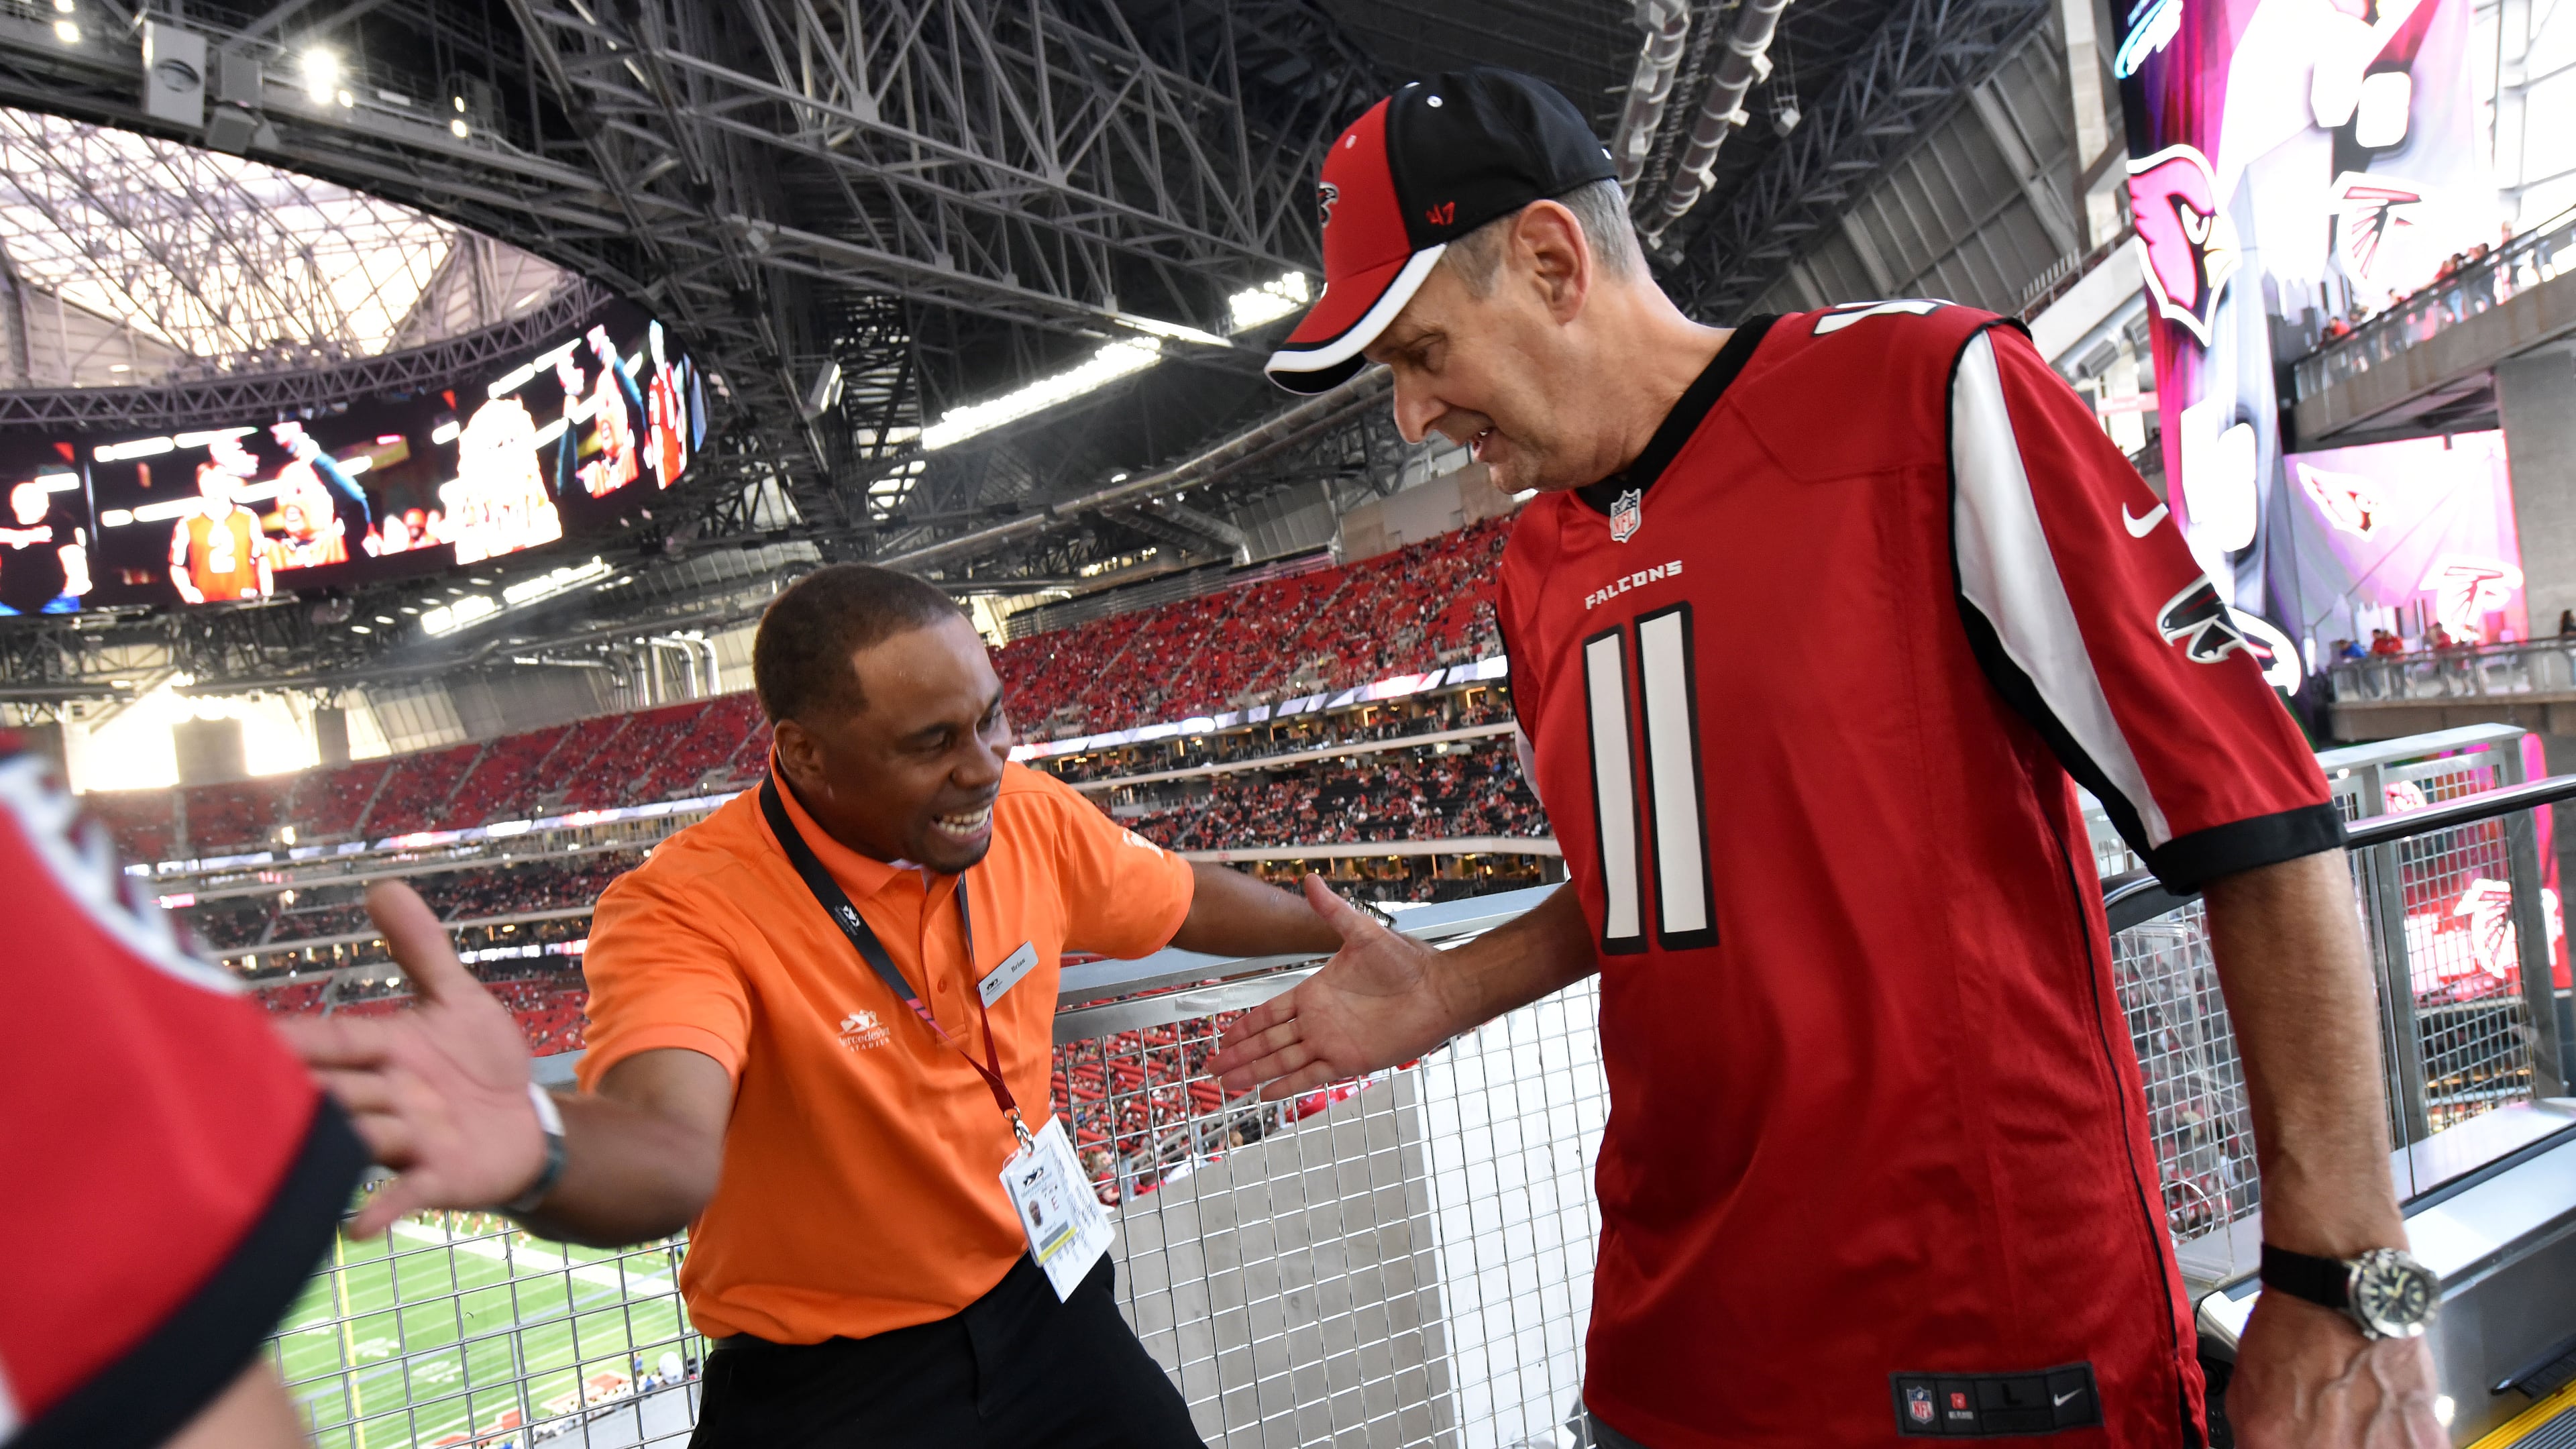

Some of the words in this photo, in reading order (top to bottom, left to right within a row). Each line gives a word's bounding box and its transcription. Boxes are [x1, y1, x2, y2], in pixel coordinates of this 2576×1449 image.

[1426, 202, 1455, 225] 47
[1585, 560, 1683, 610] FALCONS
[1582, 601, 1719, 956] 11
[1010, 957, 1026, 973] Brian
